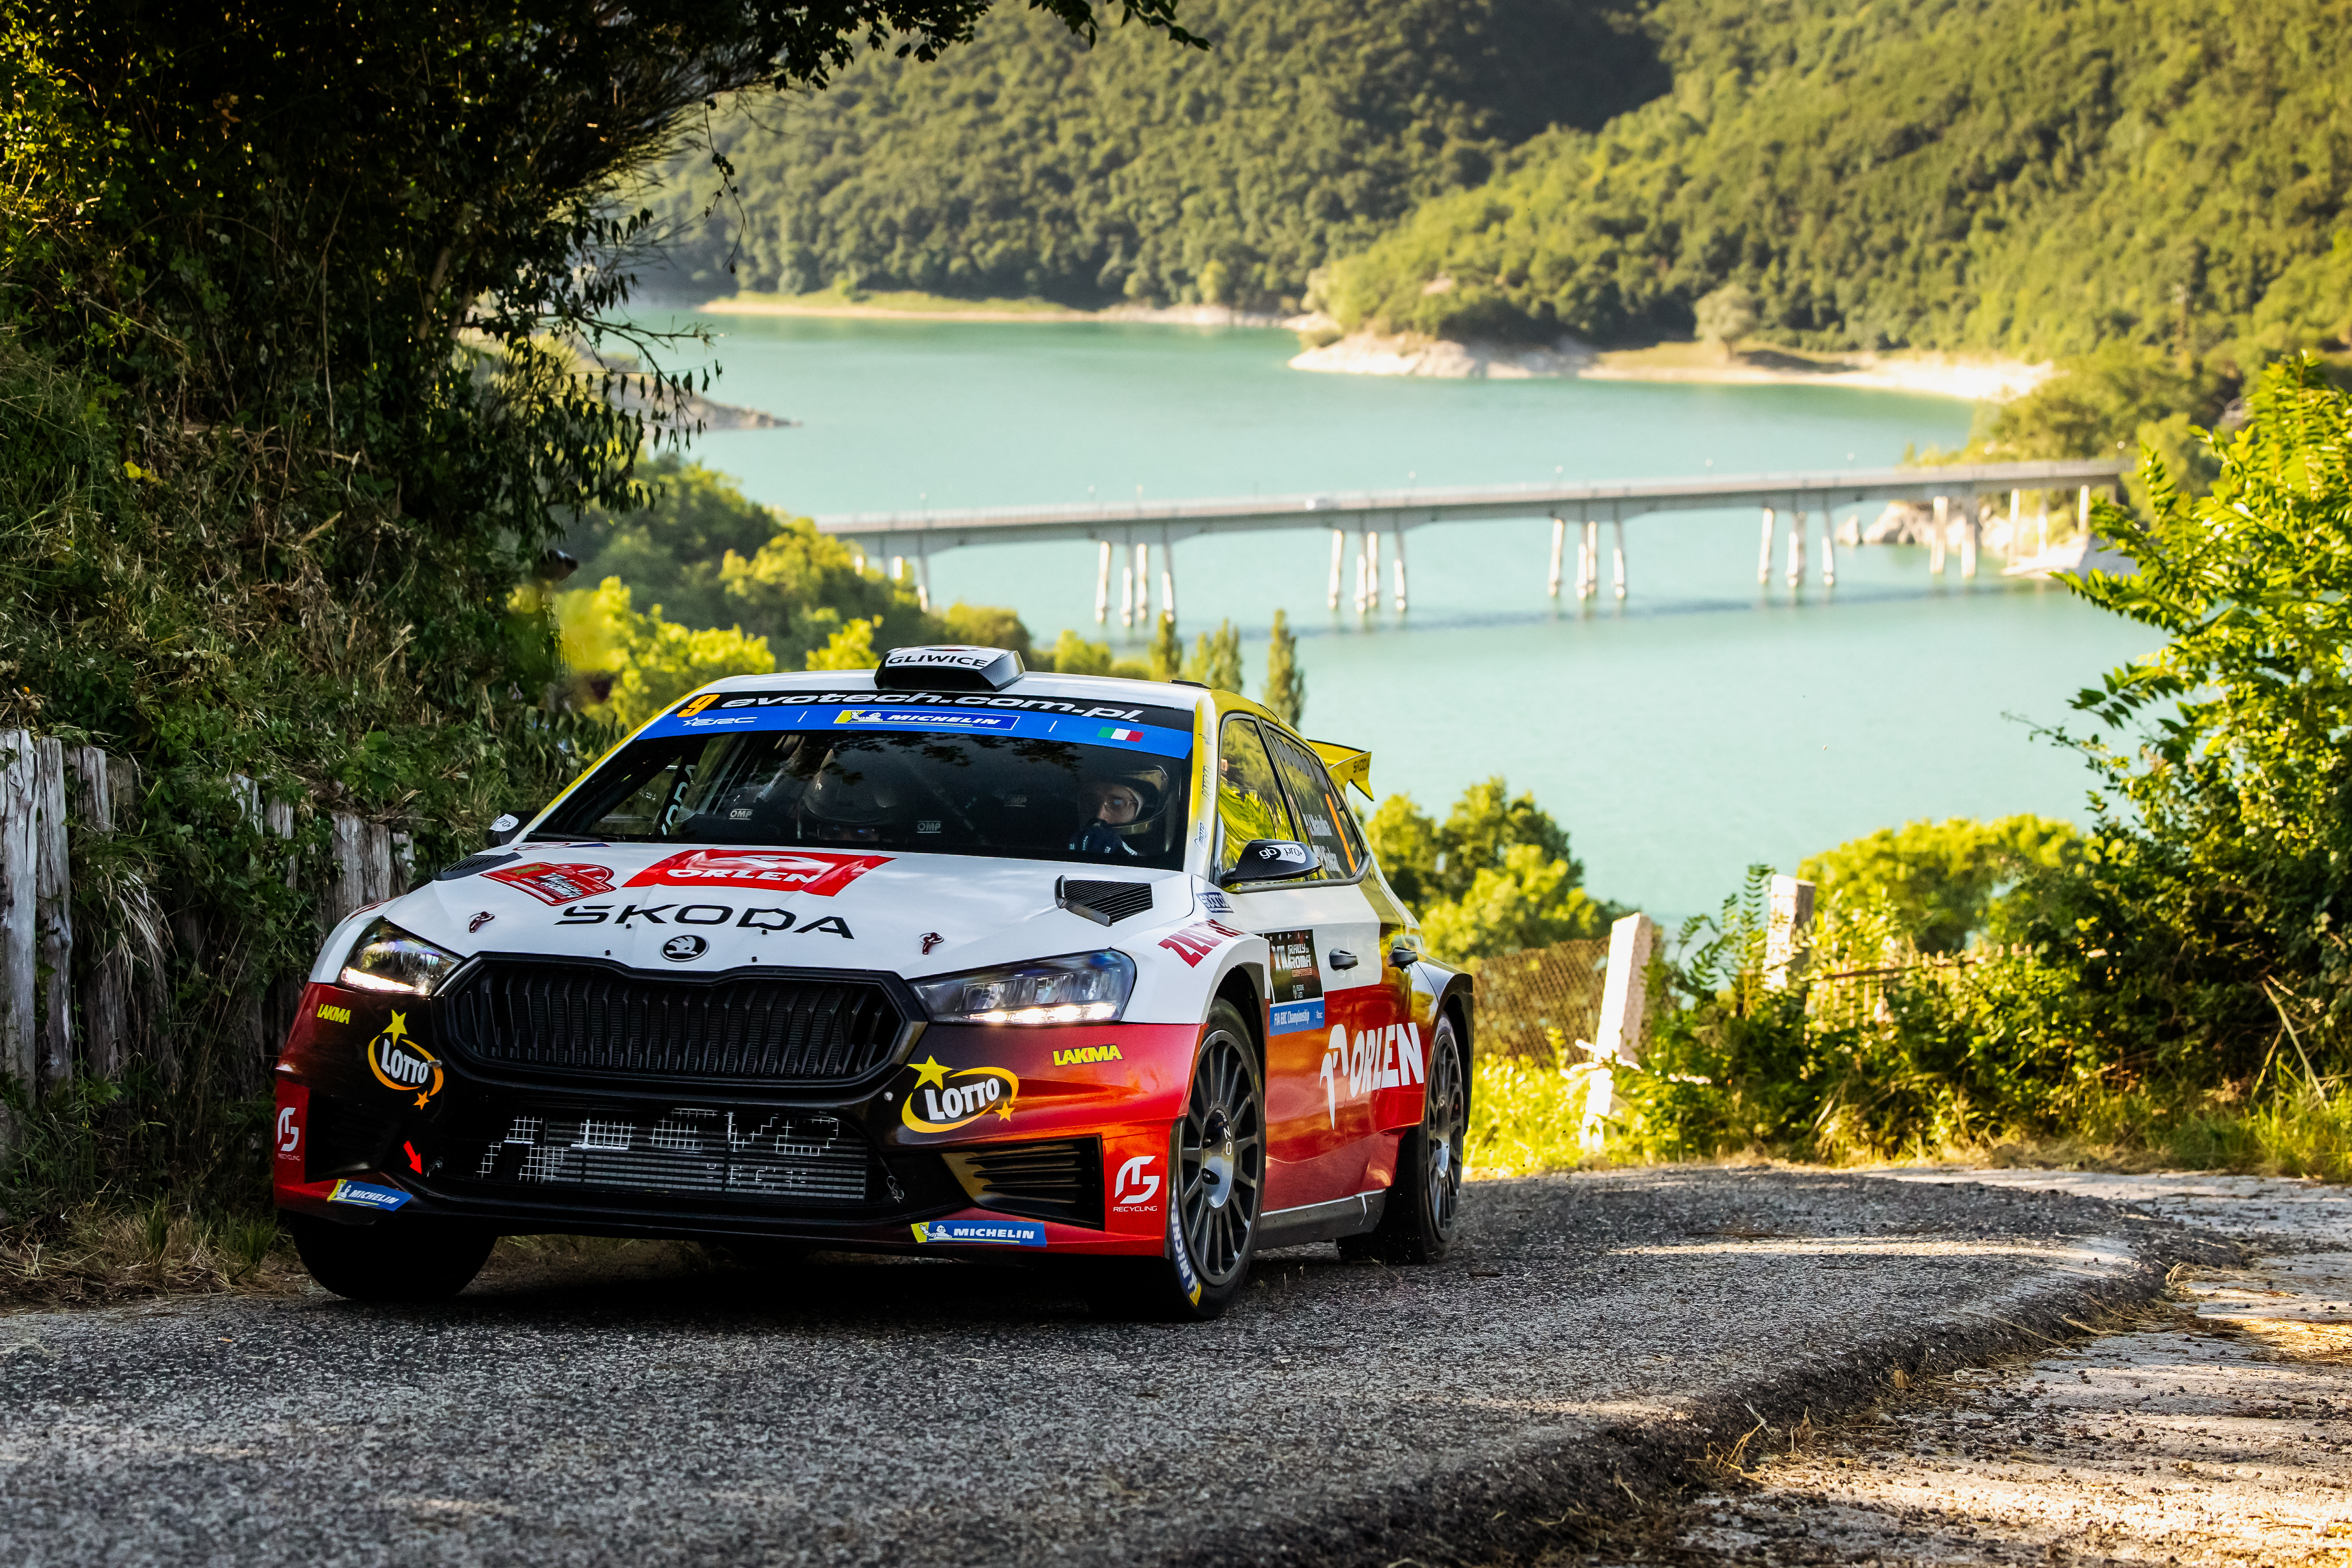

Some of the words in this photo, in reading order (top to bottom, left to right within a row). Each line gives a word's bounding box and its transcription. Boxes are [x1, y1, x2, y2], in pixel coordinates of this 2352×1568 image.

[888, 655, 988, 667] GLIWICE
[677, 694, 720, 717] 9
[887, 715, 1001, 724] MICHELIN
[730, 810, 753, 818] OMP
[917, 823, 940, 831] OMP
[667, 869, 822, 883] ORLEN
[1199, 894, 1229, 912] sparco
[1288, 943, 1305, 954] RALLY
[1290, 955, 1311, 969] ROMA
[317, 1004, 351, 1024] LAKMA
[381, 1038, 428, 1083] LOTTO
[1053, 1045, 1123, 1065] LAKMA
[1349, 1022, 1424, 1097] ORLEN
[925, 1078, 999, 1120] LOTTO
[348, 1190, 400, 1204] MICHELIN
[953, 1227, 1035, 1239] MICHELIN
